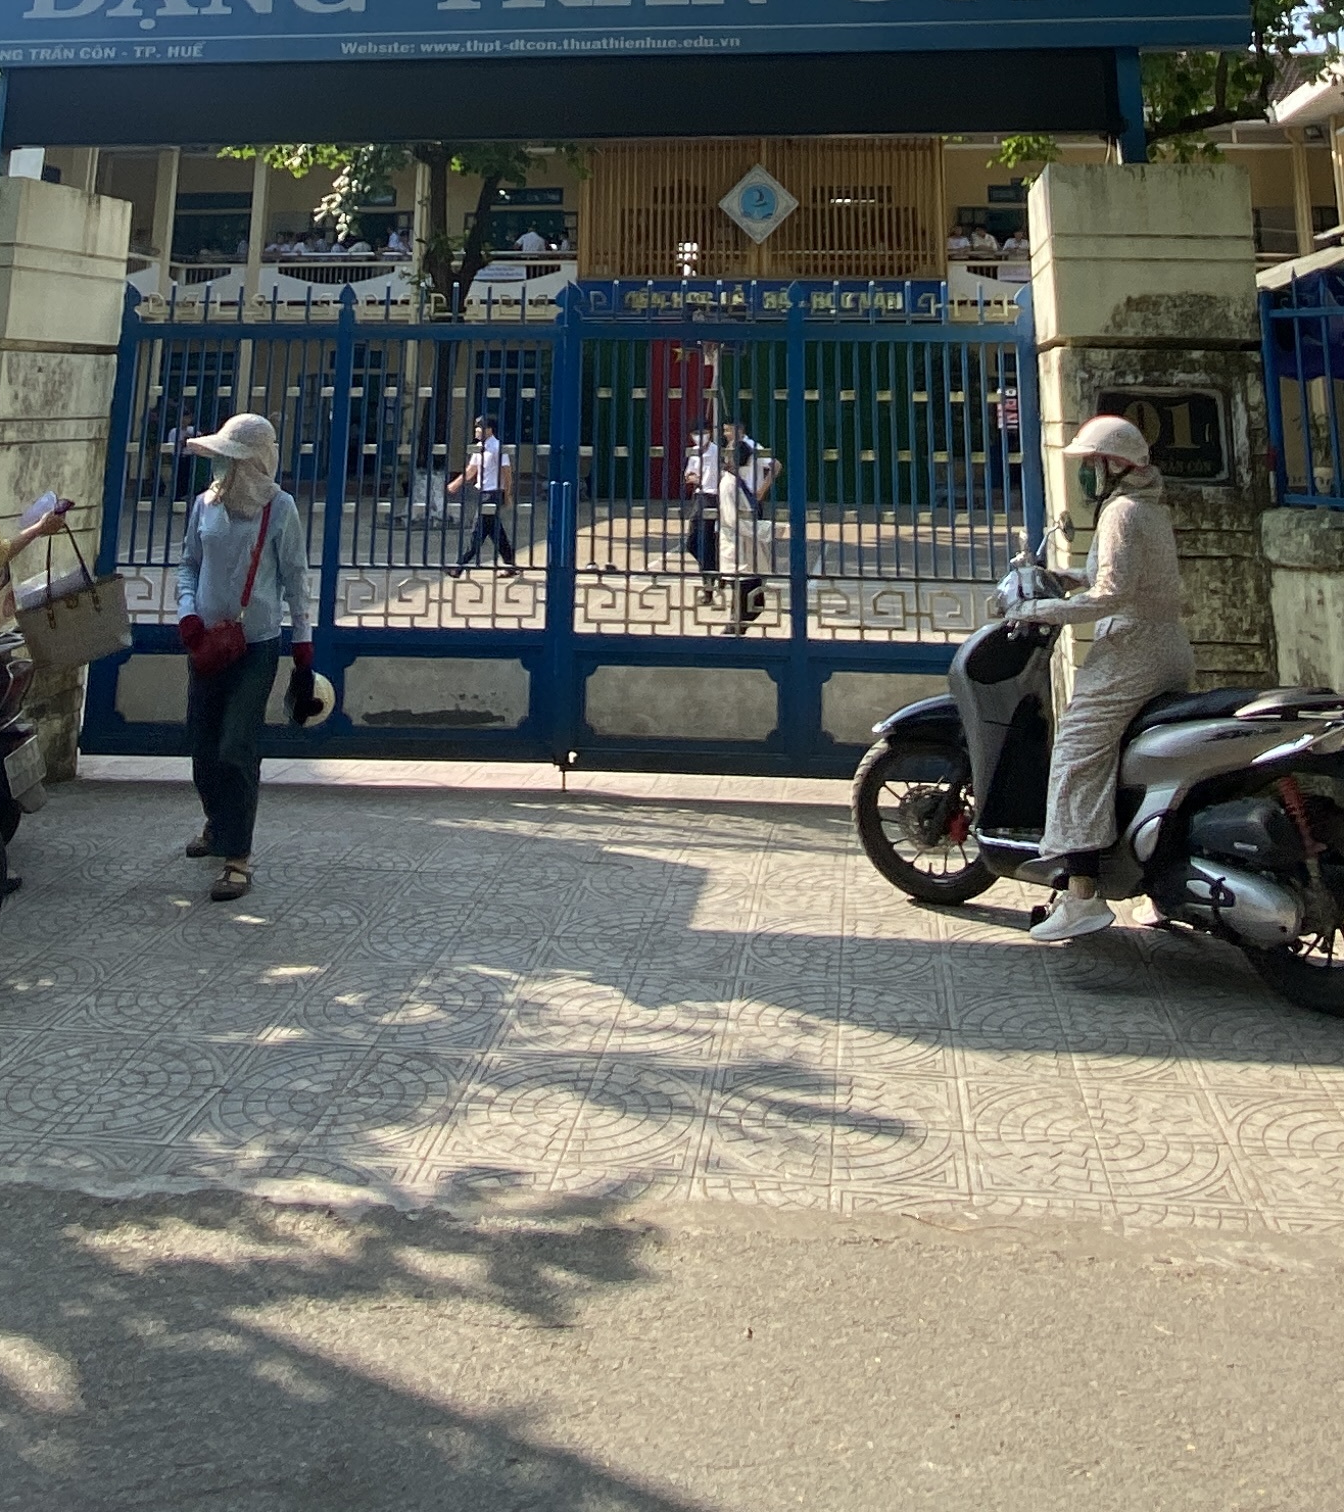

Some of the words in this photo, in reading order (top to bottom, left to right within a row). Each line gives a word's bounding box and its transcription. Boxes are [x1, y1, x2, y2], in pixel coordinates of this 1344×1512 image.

[29, 43, 75, 60] TRẦN
[79, 44, 116, 59] CÔN
[133, 46, 162, 59] TP.
[167, 40, 207, 58] HUẾ
[341, 41, 415, 55] Website:
[420, 35, 741, 53] www.thpt-dtcon.thuathienhue.edu.vn
[1122, 400, 1202, 449] 01
